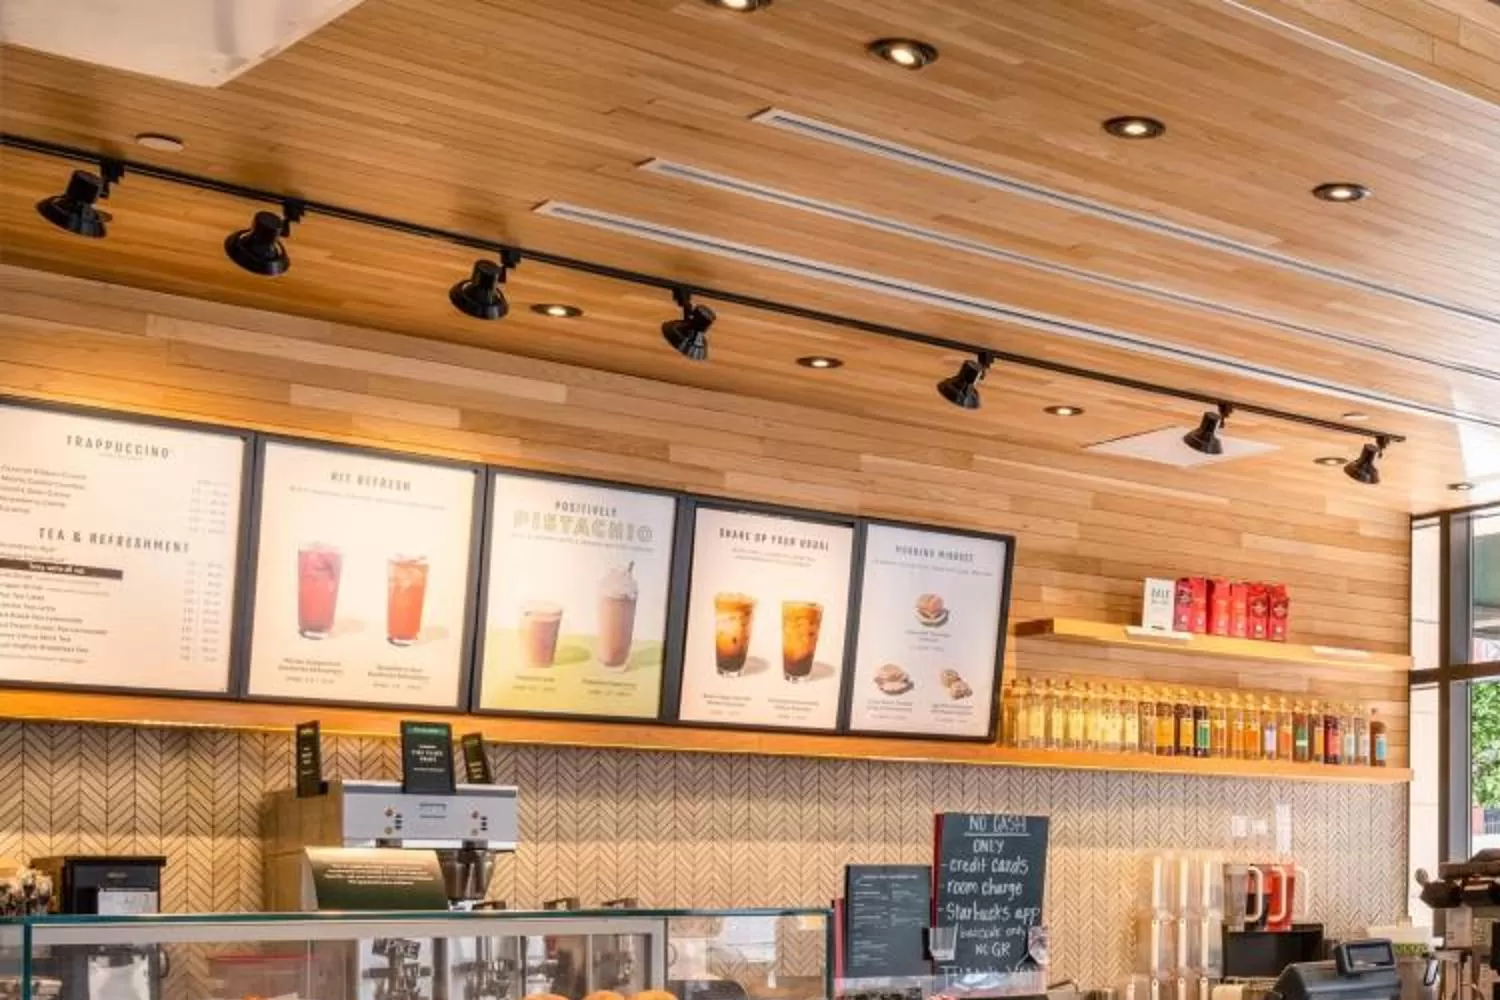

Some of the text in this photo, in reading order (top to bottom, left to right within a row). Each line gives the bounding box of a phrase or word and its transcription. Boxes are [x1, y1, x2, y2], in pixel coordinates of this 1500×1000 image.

[969, 814, 1027, 833] NO CASH
[972, 839, 1005, 854] ONLY
[947, 879, 979, 895] room
